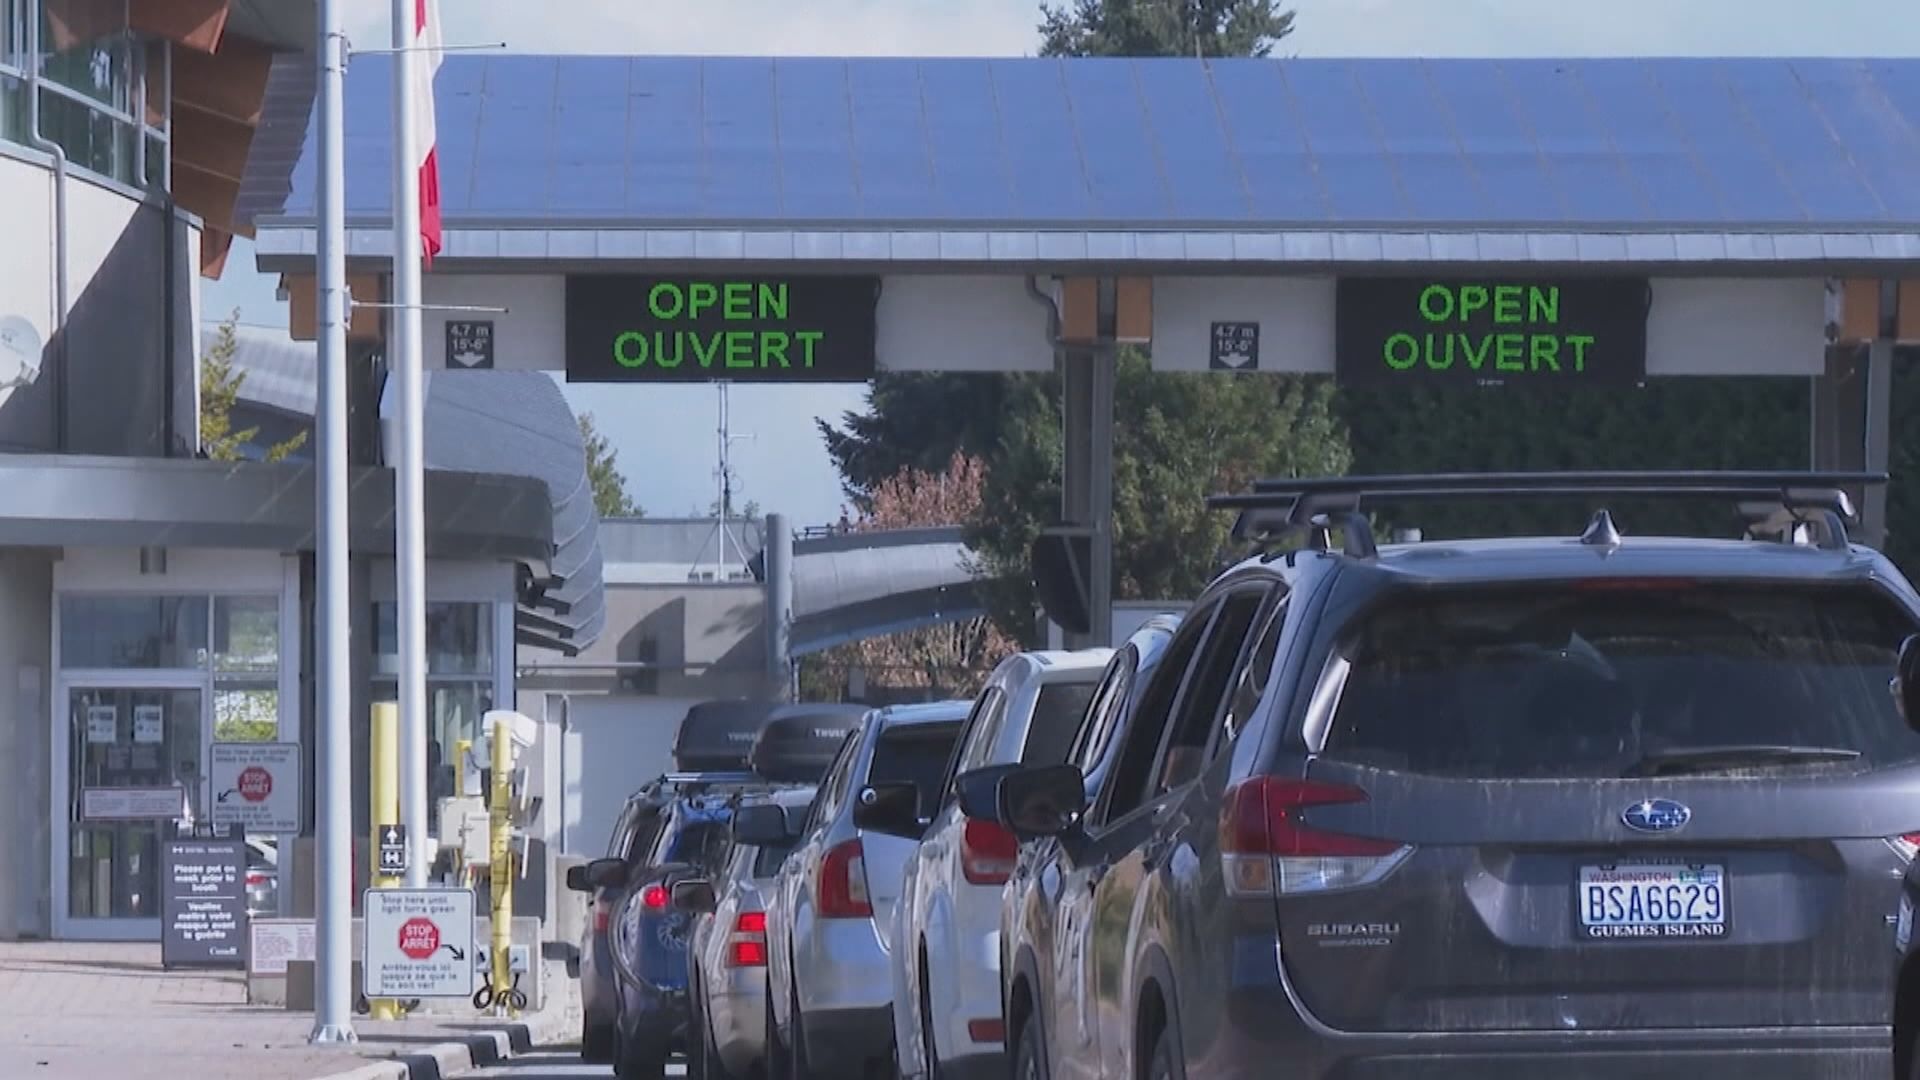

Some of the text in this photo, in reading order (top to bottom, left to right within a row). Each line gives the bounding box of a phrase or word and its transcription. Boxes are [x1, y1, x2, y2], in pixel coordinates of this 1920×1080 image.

[648, 283, 789, 320] OPEN
[1419, 284, 1560, 323] OPEN
[450, 324, 489, 337] 4.7 m
[1215, 325, 1254, 337] 4.7 m
[613, 332, 824, 368] OUVERT
[1384, 333, 1595, 371] OUVERT
[243, 773, 267, 782] STOP
[174, 865, 204, 873] Please
[206, 865, 221, 874] put
[174, 874, 235, 884] mask prior to
[1589, 872, 1673, 883] WASHINGTON
[191, 883, 218, 891] booth
[187, 902, 222, 910] Veuillez
[1588, 884, 1721, 922] BSA6629
[177, 912, 206, 920] mettre
[430, 906, 456, 914] green
[174, 921, 236, 931] masque avant
[405, 924, 433, 937] STOP
[1307, 922, 1400, 936] SUBARU
[1588, 923, 1724, 937] GUEMES ISLAND
[402, 935, 436, 949] ARRÊT
